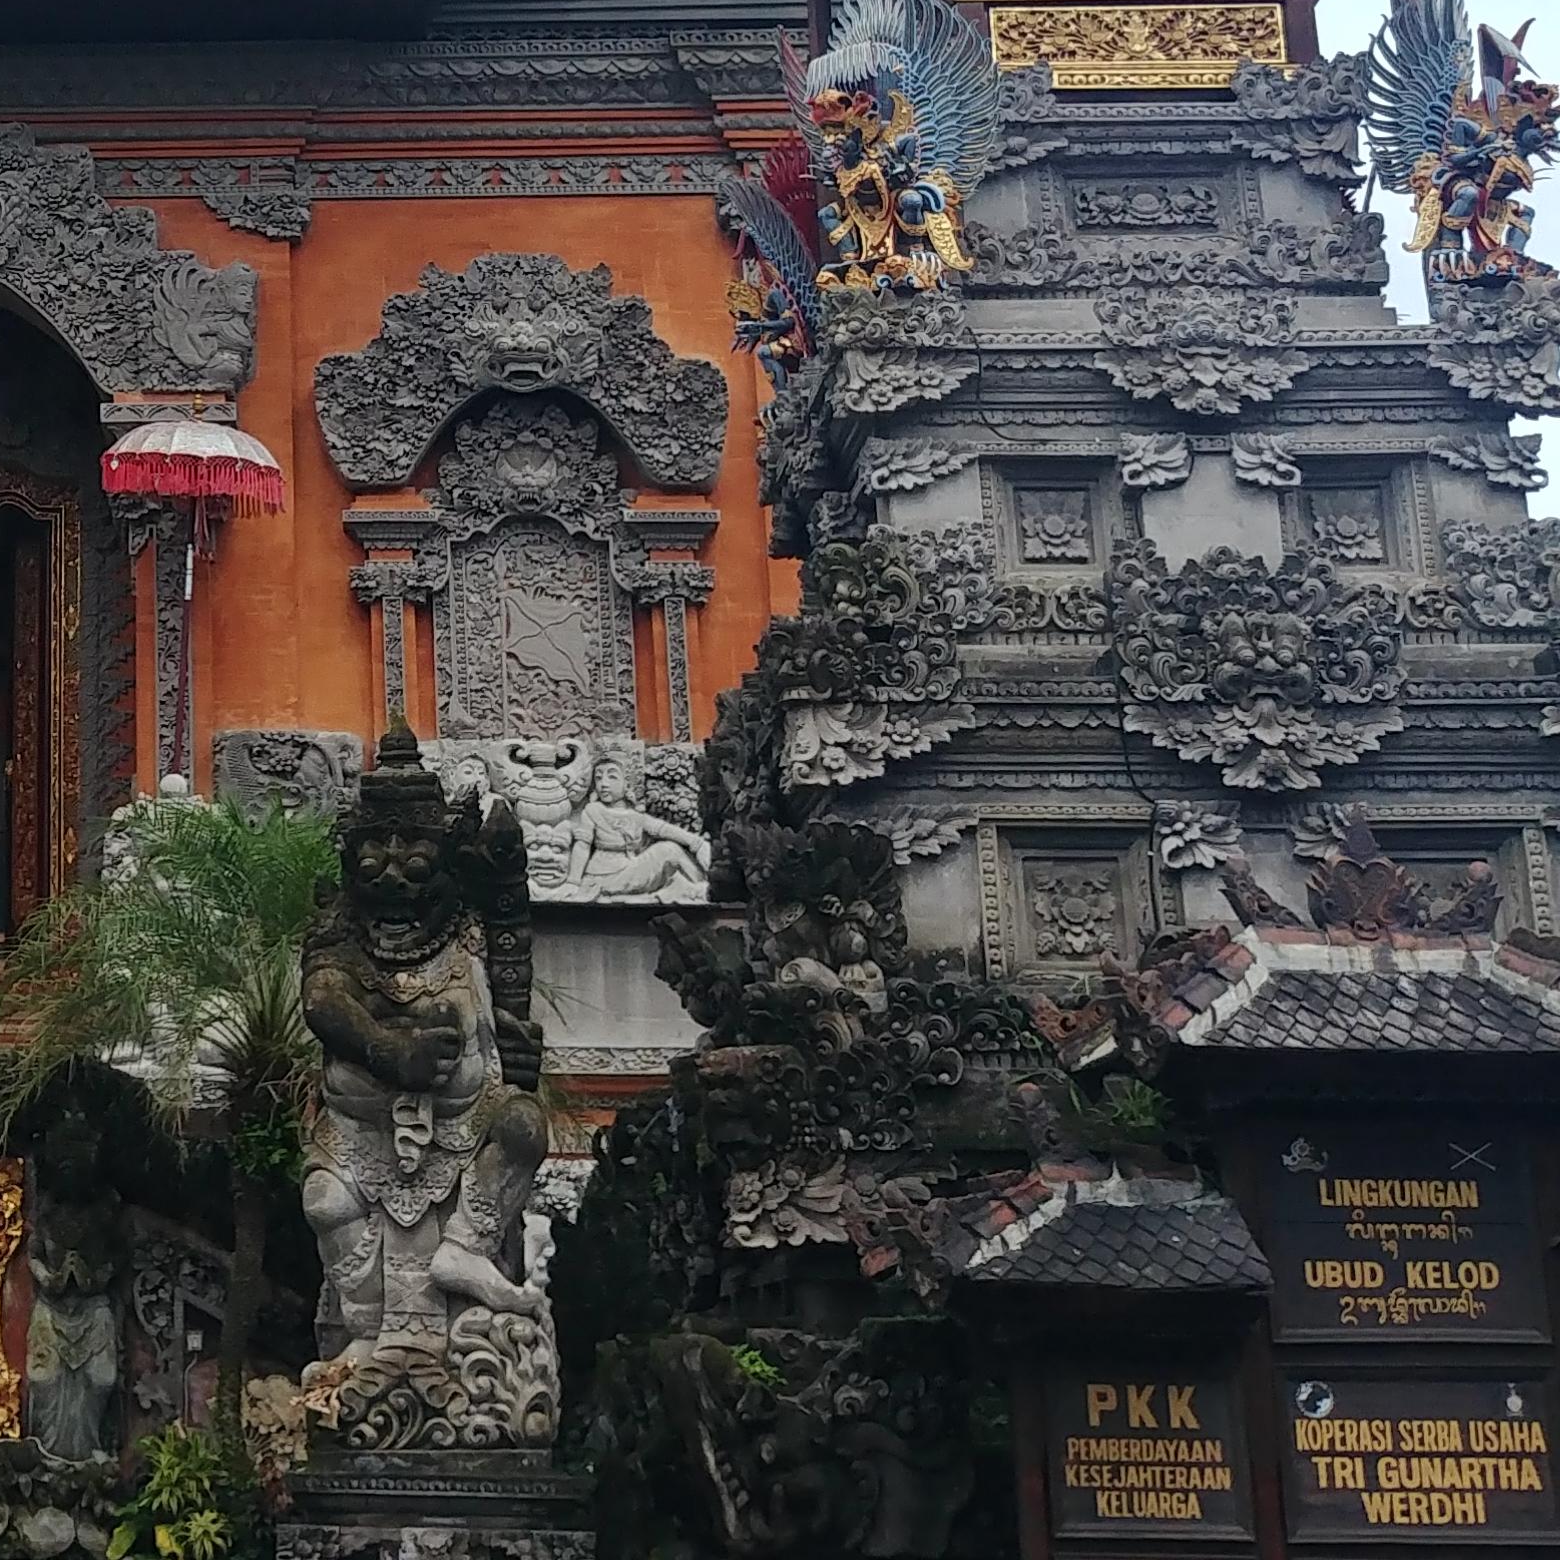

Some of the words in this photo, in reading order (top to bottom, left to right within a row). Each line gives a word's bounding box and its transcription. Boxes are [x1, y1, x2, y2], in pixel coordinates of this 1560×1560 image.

[1319, 1178, 1479, 1208] LINGKUNGAN
[1304, 1260, 1384, 1288] UBUD
[1406, 1260, 1500, 1290] KELOD
[1066, 1437, 1223, 1463] PEMBERDAYAAN
[1295, 1418, 1393, 1453] KOPERASI
[1398, 1419, 1464, 1453] SERBA
[1468, 1420, 1548, 1453] USAHA
[1064, 1464, 1232, 1491] KESEJAHTERAAN
[1310, 1456, 1366, 1489] TRI
[1376, 1456, 1543, 1490] GUNARTHA
[1095, 1490, 1202, 1520] KELUARGA
[1360, 1492, 1487, 1525] WERDHI
